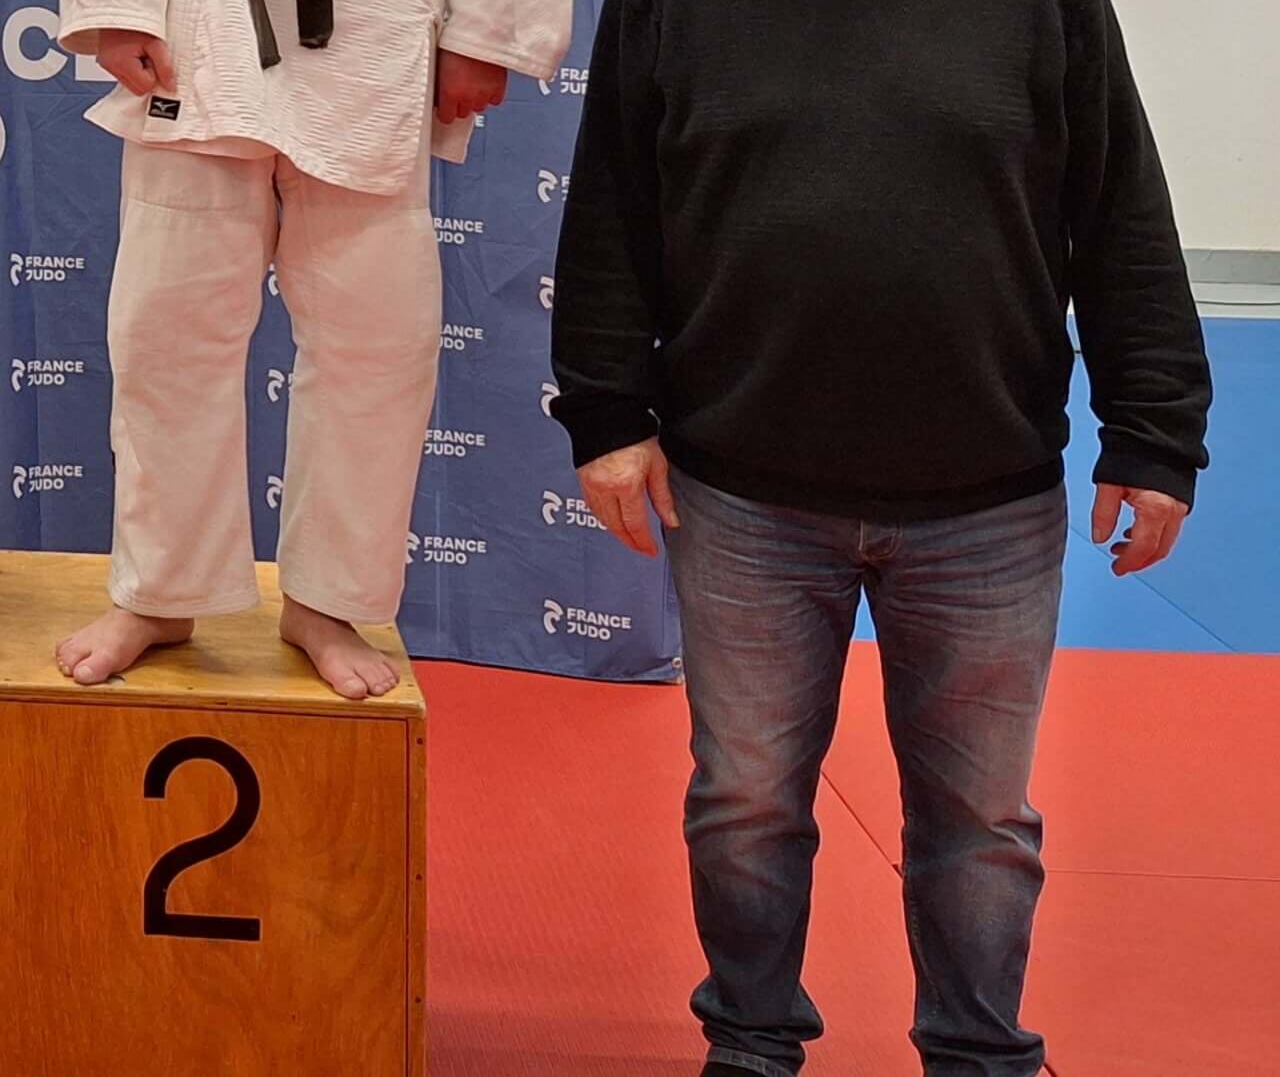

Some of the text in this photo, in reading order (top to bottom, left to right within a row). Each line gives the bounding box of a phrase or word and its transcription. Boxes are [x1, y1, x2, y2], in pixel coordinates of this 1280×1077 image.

[561, 68, 589, 80] FRA
[433, 218, 483, 233] RANCE
[435, 231, 465, 244] UDO
[25, 257, 84, 269] FRANCE
[25, 269, 66, 281] JUDO
[440, 324, 484, 339] ANCE
[27, 360, 84, 373] FRANCE
[28, 374, 65, 385] JUDO
[425, 430, 486, 446] FRANCE
[424, 443, 466, 457] JUDO
[29, 465, 83, 478] FRANCE
[29, 478, 64, 491] JUDO
[566, 512, 607, 530] JUD
[424, 536, 487, 553] FRANCE
[424, 550, 467, 564] JUDO
[567, 608, 631, 629] FRANCE
[567, 622, 611, 640] JUDO
[144, 736, 261, 941] 2
